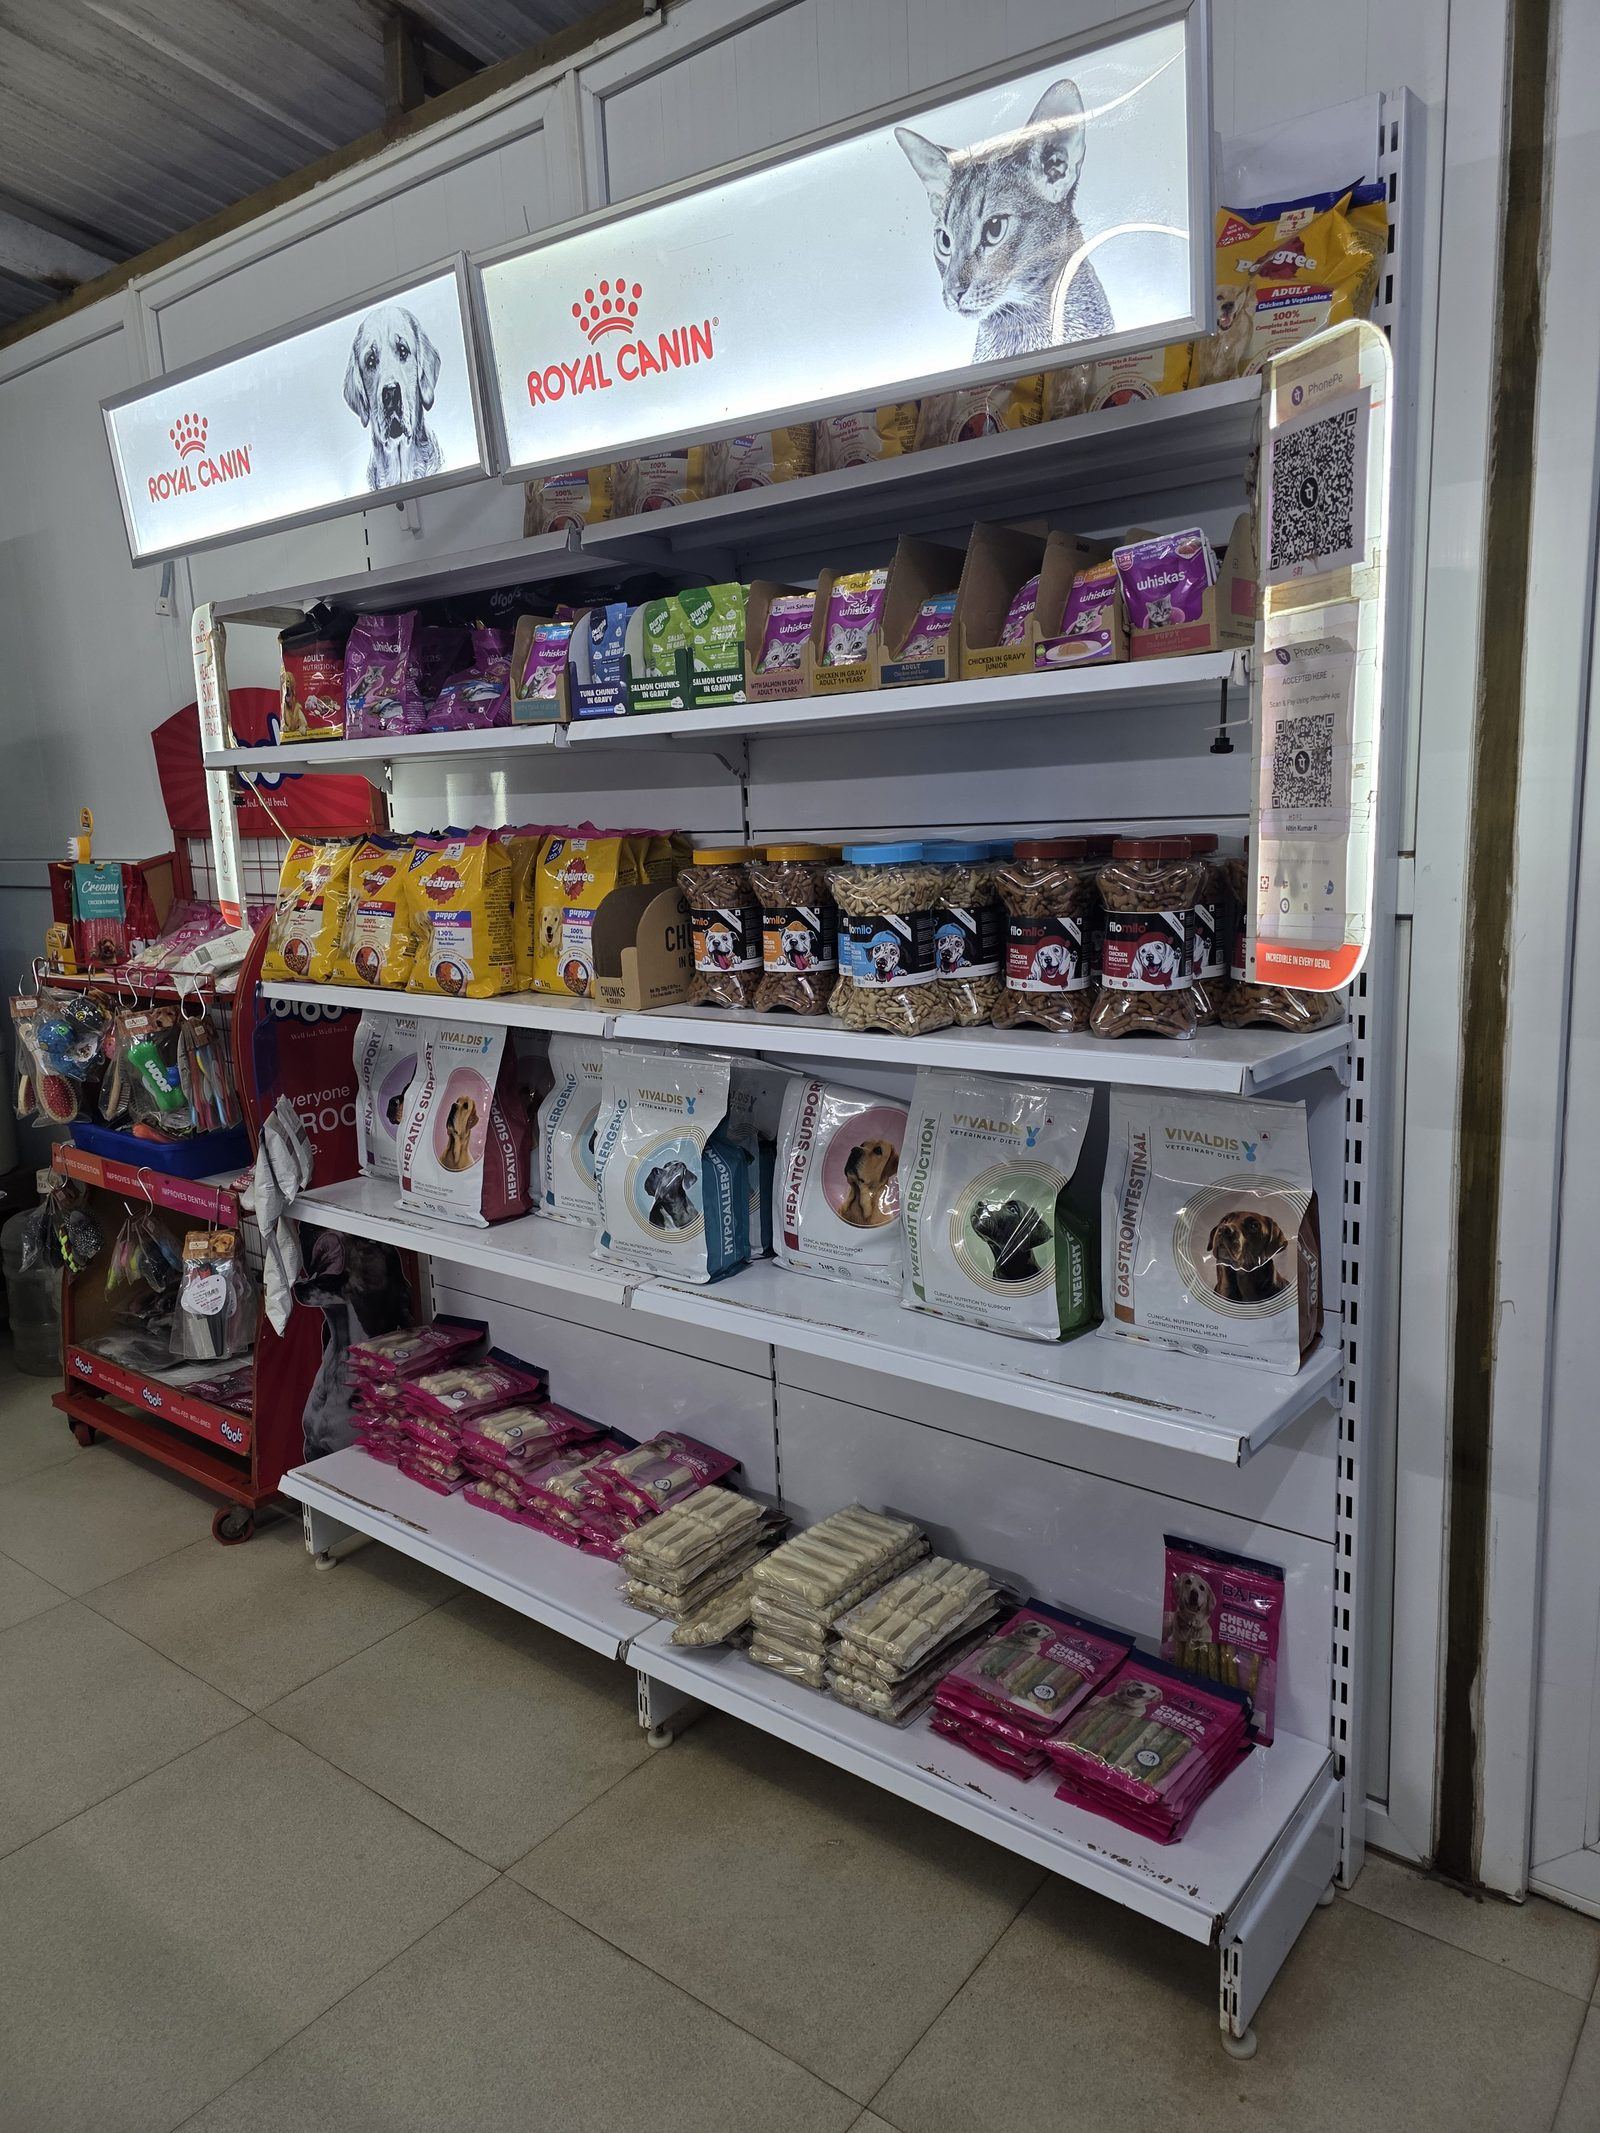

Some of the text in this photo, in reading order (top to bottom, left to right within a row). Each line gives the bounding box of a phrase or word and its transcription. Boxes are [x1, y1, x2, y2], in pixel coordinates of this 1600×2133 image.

[1271, 286, 1311, 297] ADULT
[1258, 300, 1284, 310] Chicken
[1292, 293, 1327, 304] Vegetables
[1273, 309, 1300, 321] 100%
[527, 319, 714, 407] ROYAL CANIN
[1307, 373, 1343, 396] PhonePe
[148, 445, 251, 503] ROYAL CANIN
[1136, 570, 1186, 591] whiskas
[1079, 586, 1116, 603] whiskas
[690, 600, 713, 622] purple
[839, 604, 875, 617] whiskas
[649, 611, 669, 631] purple
[779, 621, 812, 634] whiskas
[372, 640, 401, 654] whiska
[538, 648, 568, 658] whiskas
[303, 654, 325, 663] ADULT
[968, 652, 1026, 666] CHICKEN IN GRAVY
[985, 662, 1008, 671] JUNIOR
[302, 663, 336, 671] NUTRITION
[815, 669, 867, 680] CHICKEN IN GRAVY
[901, 663, 921, 671] ADULT
[630, 680, 680, 692] SALMON CHUNKS
[692, 673, 743, 687] SALMON CHUNKS
[762, 681, 781, 689] SALMON
[785, 678, 804, 686] GRAVY
[819, 678, 838, 686] ADULT
[845, 676, 864, 684] YEARS
[1282, 670, 1328, 687] ACCEPTED HERE
[580, 687, 619, 698] TUNA CHUNKS
[641, 689, 669, 699] IN GRAVY
[703, 683, 732, 693] IN GRAVY
[757, 688, 773, 696] ADULT
[594, 695, 613, 704] GRAVY
[1297, 824, 1313, 832] Kumar
[418, 876, 466, 891] Pedigree
[556, 869, 595, 884] Pedigree
[81, 880, 119, 895] Creamy
[434, 911, 458, 921] puppy
[568, 908, 591, 918] puppy
[1010, 925, 1045, 937] filomilo
[1109, 921, 1146, 933] filomilo
[1265, 952, 1293, 965] INCREDIBLE
[1292, 955, 1298, 965] IN
[1298, 956, 1315, 967] EVERY
[600, 986, 626, 998] CHUNKS
[440, 1031, 483, 1046] VIVALDIS
[277, 1086, 350, 1108] veryone
[637, 1088, 684, 1106] VIVALDIS
[403, 1042, 435, 1171] HEPATIC SUPPORT
[546, 1072, 577, 1182] HYPOALLERGENIC
[952, 1113, 1024, 1136] VIVALDIS
[949, 1129, 1021, 1147] VETERINARY DIETS
[1164, 1127, 1240, 1151] VIVALDIS
[597, 1098, 628, 1223] HYPOALLERGENIC
[1164, 1144, 1241, 1161] VETERINARY DIETS
[504, 1143, 518, 1200] HEPATIC
[77, 1162, 208, 1208] DIGESTION IMPROVES IMPROVES DENTAL
[786, 1154, 808, 1227] HEPATIC
[907, 1118, 936, 1278] WEIGHT REDUCTION
[1117, 1132, 1148, 1298] GASTROINTESTINAL
[1071, 1242, 1082, 1309] WEIGHT
[933, 1290, 1012, 1312] CLINICAL NUTRITION SUPPORT
[1147, 1312, 1172, 1323] CLINICAL
[1173, 1318, 1205, 1328] NUTRITION
[1147, 1320, 1227, 1339] GASTROINTESTINAL HEALTH
[75, 1355, 243, 1443] drools drools drools
[1220, 1612, 1260, 1633] CHEWS
[1219, 1622, 1258, 1642] BONES
[1049, 1647, 1088, 1669] BONES
[1053, 1642, 1092, 1662] CHEWS
[1154, 1708, 1196, 1732] BONES
[1159, 1704, 1200, 1727] CHEWS
